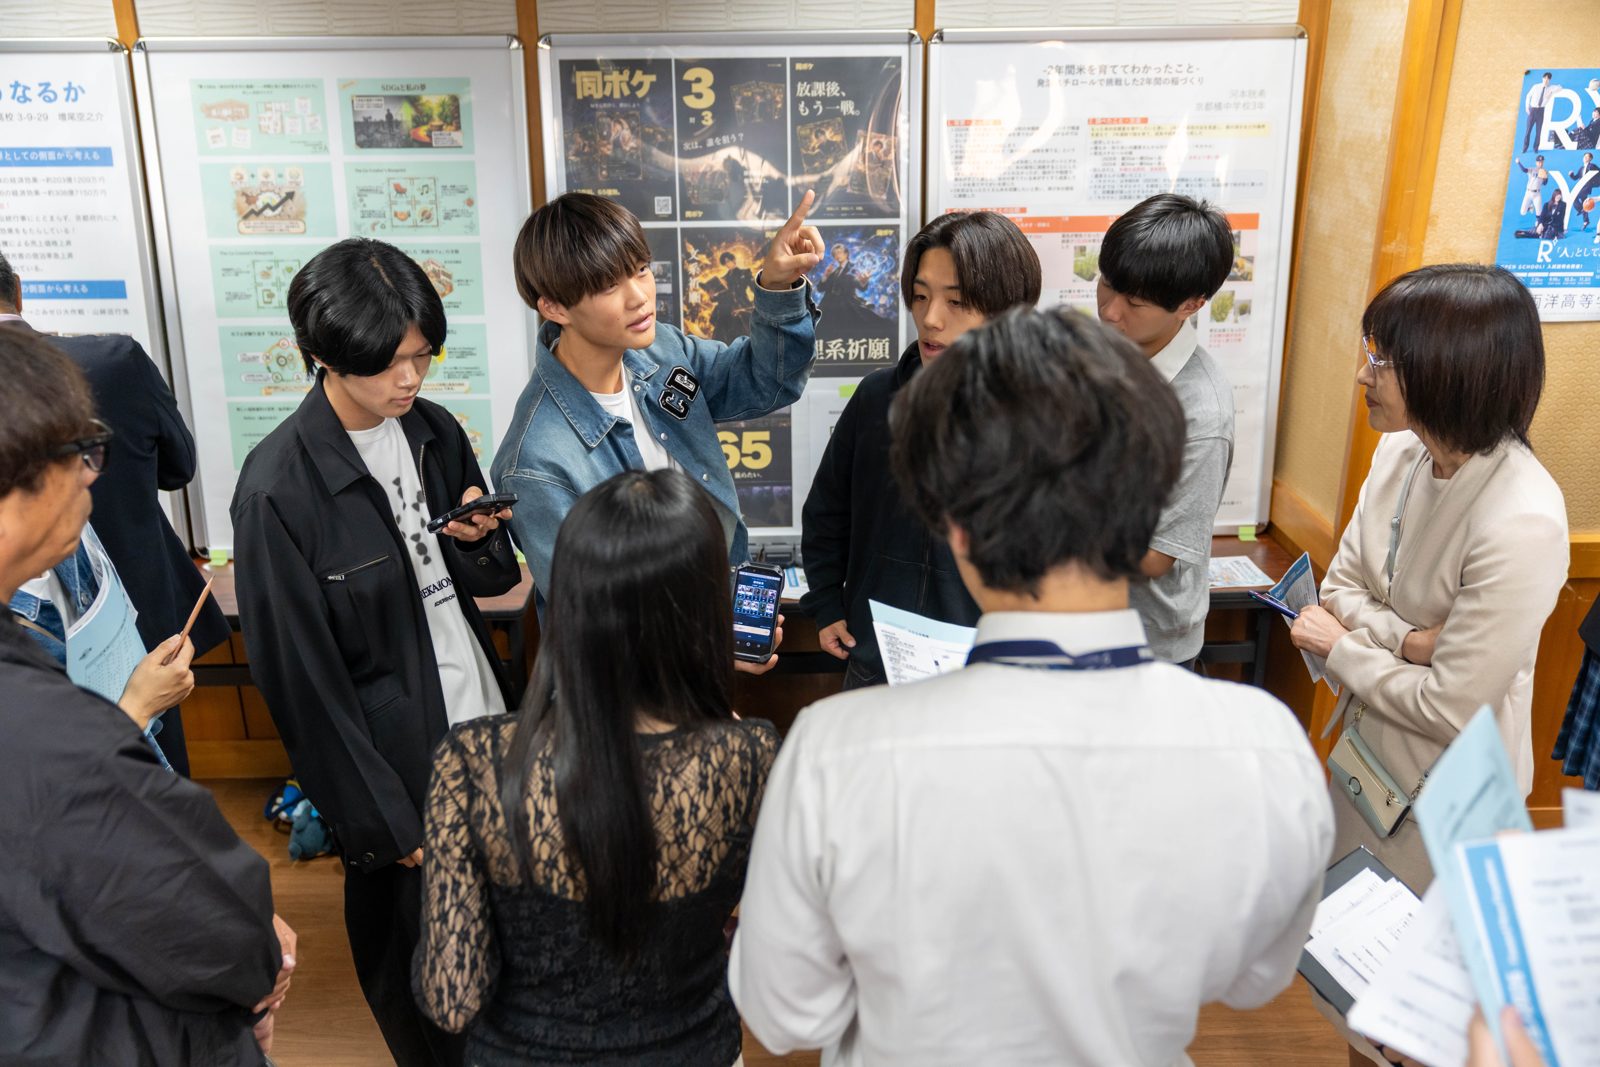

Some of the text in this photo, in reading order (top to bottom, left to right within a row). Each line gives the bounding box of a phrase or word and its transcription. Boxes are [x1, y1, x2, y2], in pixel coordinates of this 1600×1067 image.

[0, 80, 86, 104] なるか
[575, 69, 656, 99] 同ポケ
[682, 67, 716, 109] 3
[796, 81, 847, 97] 放課後、
[798, 100, 861, 116] もう一戦。
[701, 110, 714, 127] 3
[0, 151, 100, 161] としての側面から考える
[1536, 240, 1554, 263] R
